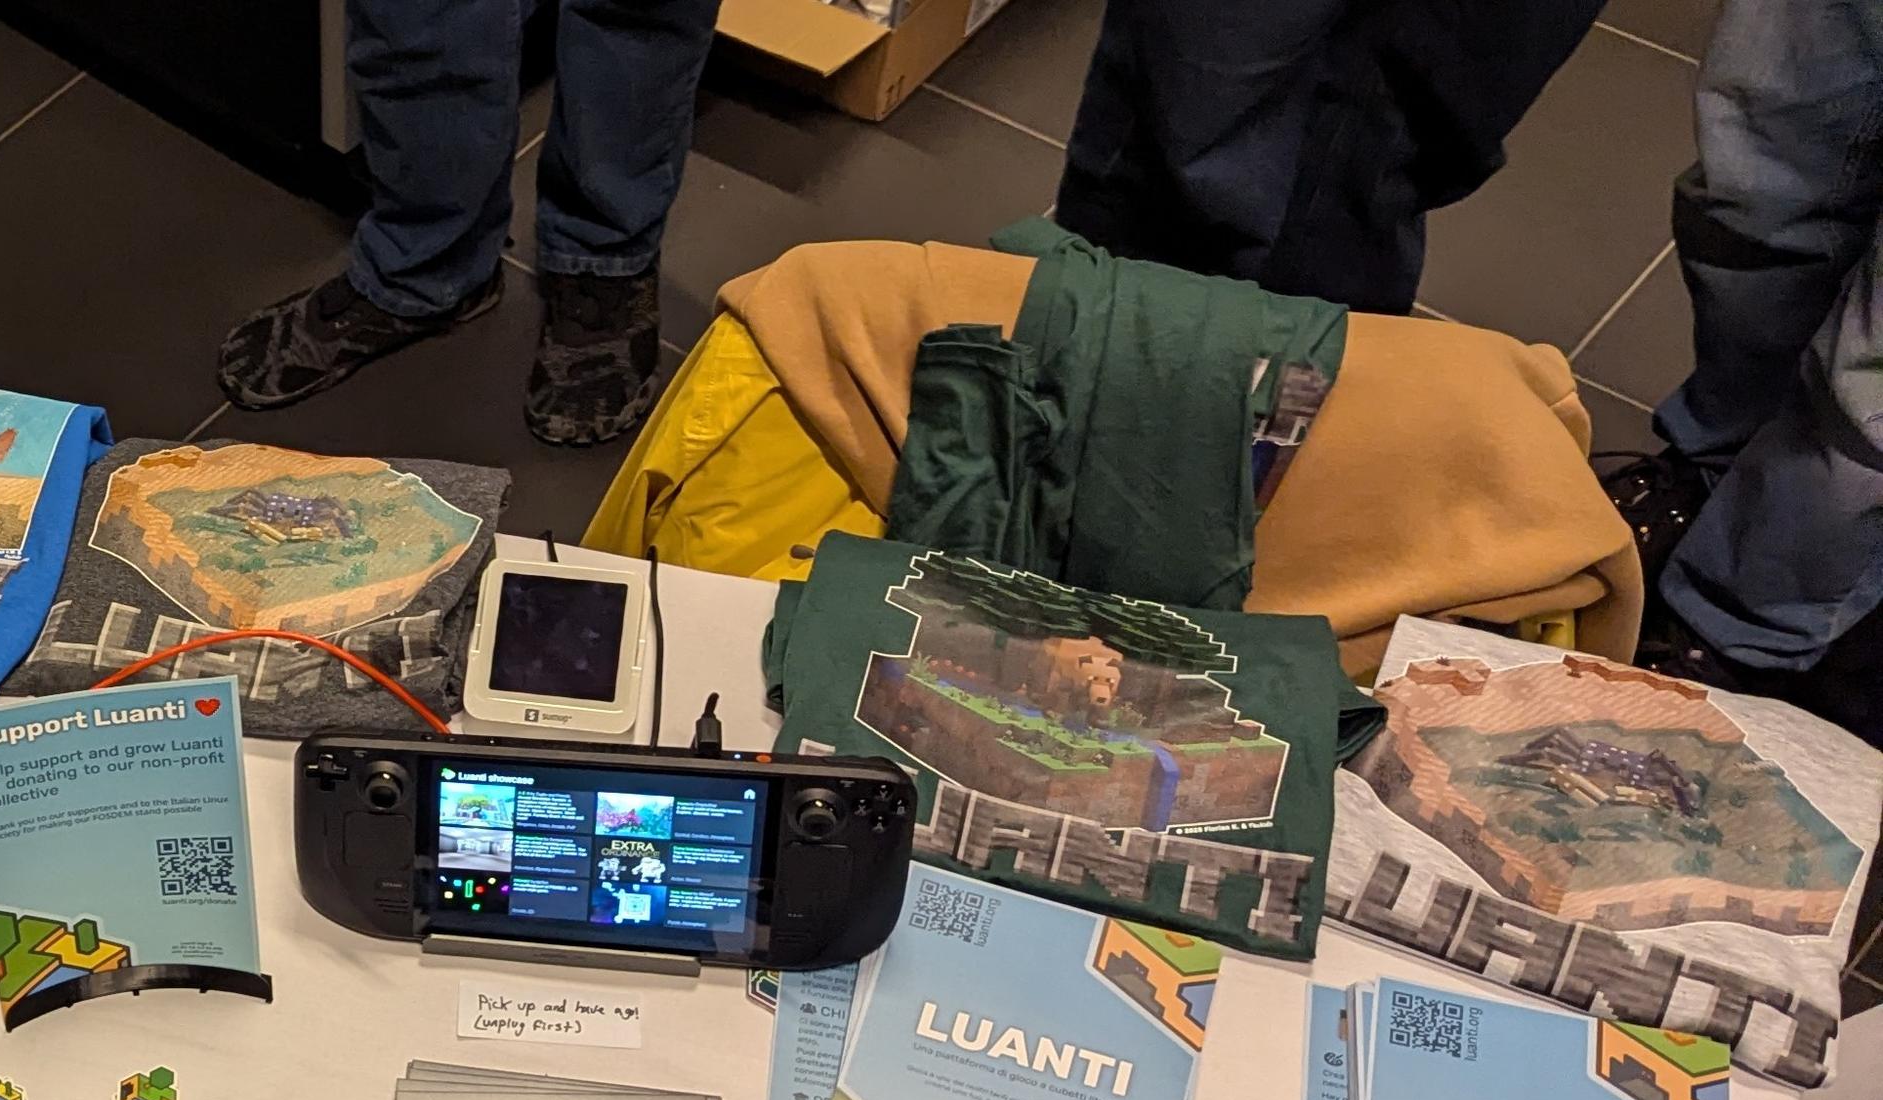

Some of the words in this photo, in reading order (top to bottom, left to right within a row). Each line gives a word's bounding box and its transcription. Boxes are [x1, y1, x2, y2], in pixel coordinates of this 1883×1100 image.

[93, 699, 186, 727] Luanti
[6, 767, 77, 790] donating
[84, 763, 100, 776] to
[107, 760, 134, 773] our
[141, 751, 226, 769] non-profit
[20, 750, 83, 772] support
[88, 745, 119, 760] and
[124, 743, 166, 758] grow
[171, 735, 223, 752] Luanti
[17, 816, 35, 828] you
[36, 814, 47, 822] to
[49, 810, 66, 821] our
[67, 802, 118, 820] supporters
[120, 800, 138, 811] and
[139, 799, 150, 807] to
[151, 797, 168, 807] the
[170, 796, 200, 805] Italian
[22, 826, 35, 835] for
[38, 819, 73, 833] making
[74, 816, 91, 825] our
[92, 810, 133, 821] FOSDEM
[135, 807, 161, 817] stand
[163, 804, 203, 816] possible
[611, 840, 654, 852] EXTRA
[974, 897, 1001, 947] luanti.org
[478, 994, 512, 1011] Pick
[517, 1002, 536, 1016] up
[544, 999, 566, 1013] and
[575, 1001, 605, 1015] have
[474, 1015, 525, 1036] (unplug
[532, 1019, 582, 1033] first)
[1465, 1005, 1484, 1062] luanti.org
[916, 1001, 1134, 1098] LUANTI
[935, 1048, 996, 1074] piattaforma
[997, 1068, 1007, 1077] di
[1009, 1071, 1038, 1088] gioco
